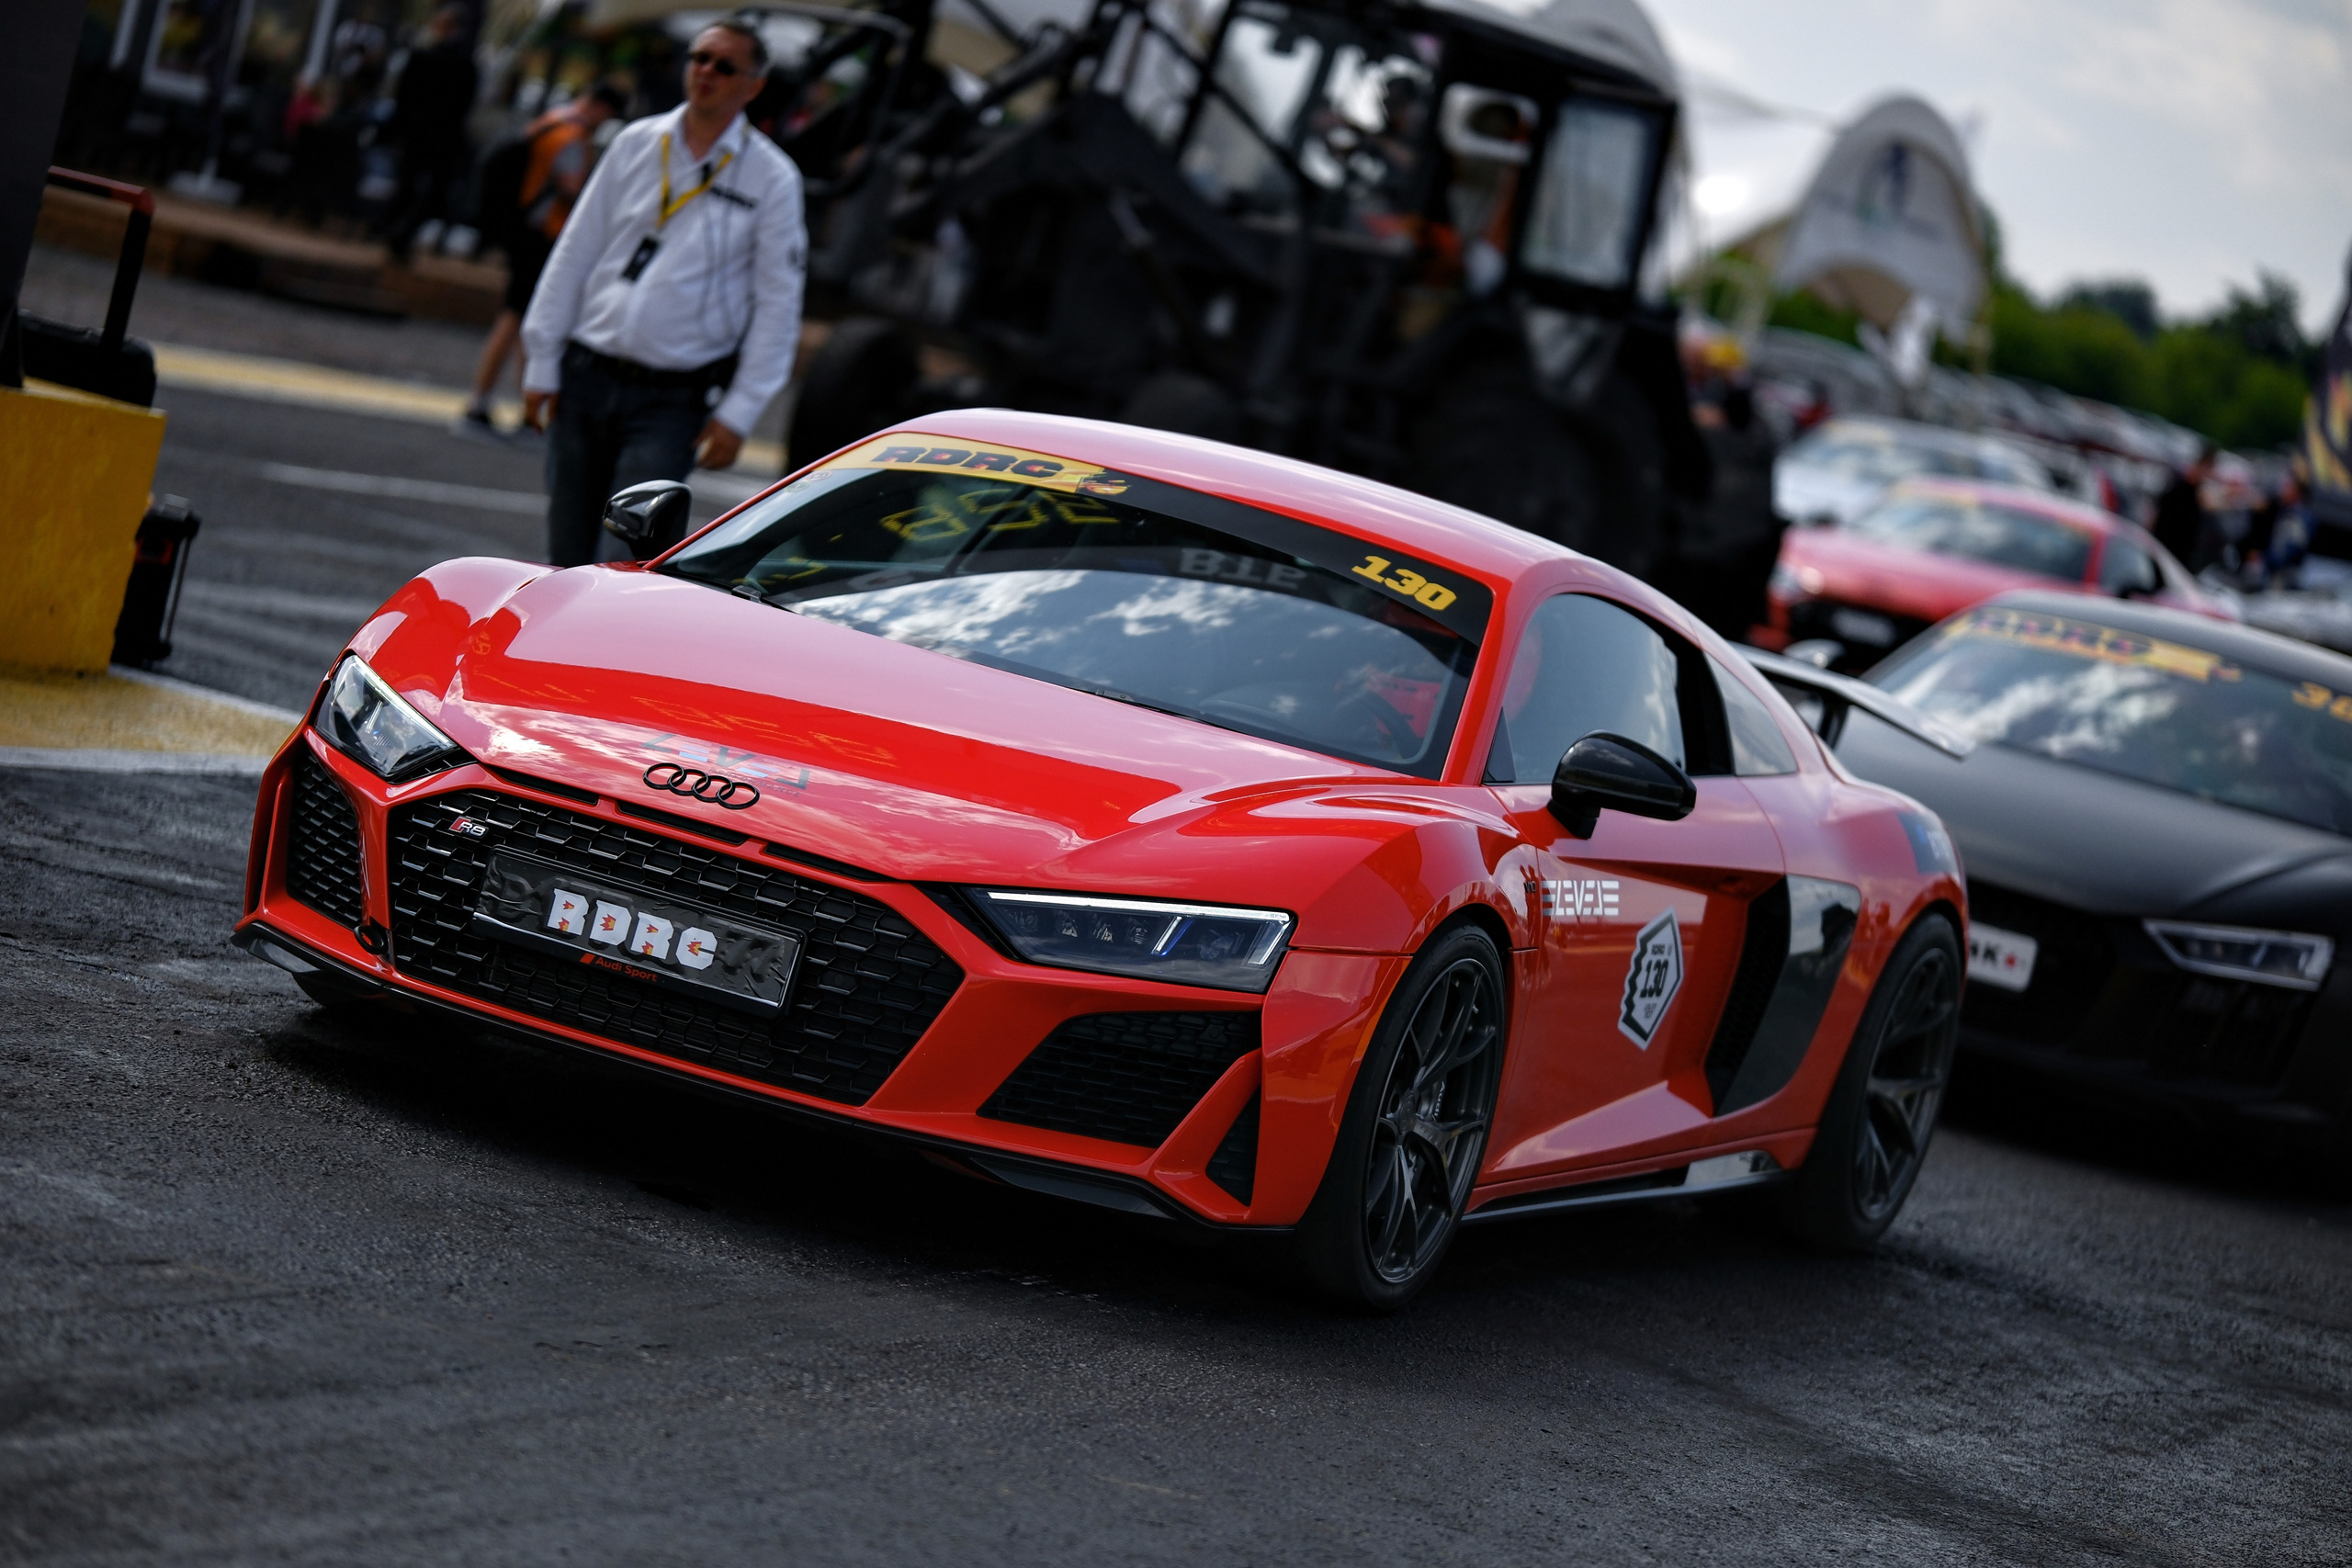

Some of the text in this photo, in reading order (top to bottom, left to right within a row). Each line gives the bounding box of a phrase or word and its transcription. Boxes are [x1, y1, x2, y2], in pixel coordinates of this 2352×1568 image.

[870, 446, 1065, 477] RDRC
[1351, 555, 1457, 611] 130
[458, 821, 486, 836] R8
[548, 888, 718, 970] RDRC
[594, 957, 659, 982] Audi Sport
[1639, 960, 1668, 998] 130
